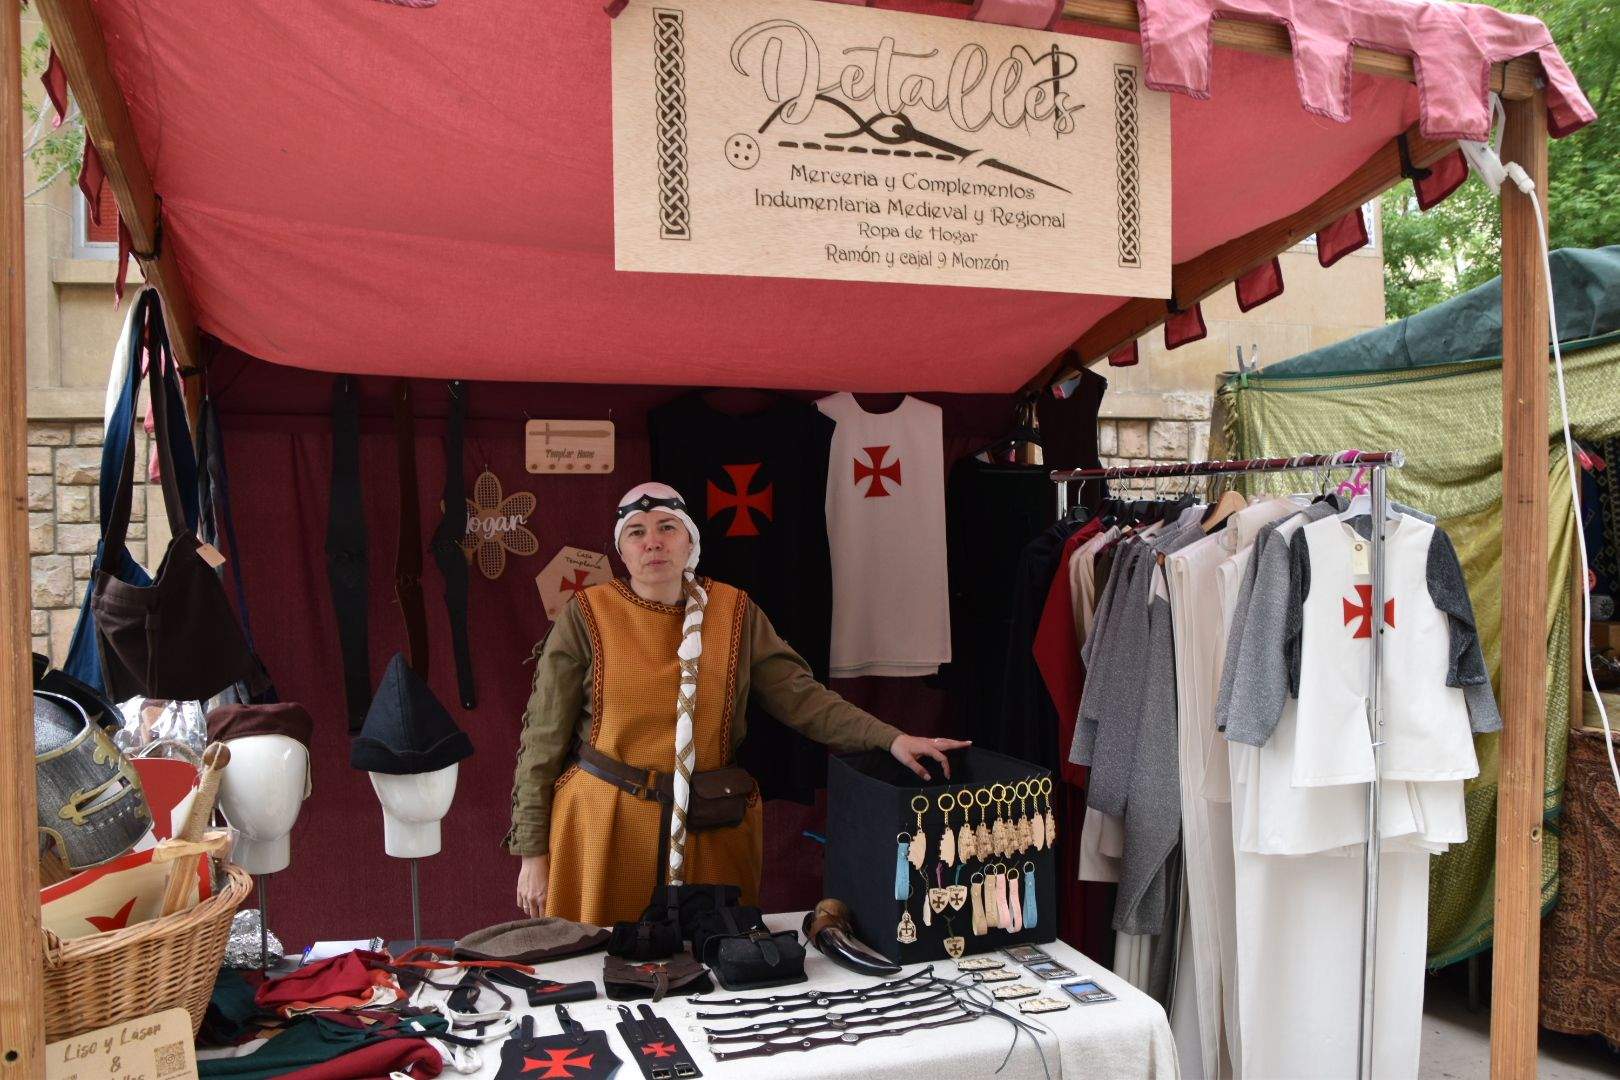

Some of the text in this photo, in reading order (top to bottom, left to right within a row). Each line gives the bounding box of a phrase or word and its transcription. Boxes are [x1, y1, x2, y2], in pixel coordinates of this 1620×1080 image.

[730, 19, 1085, 134] Detalles
[790, 164, 1035, 200] Merceria y Complementos
[755, 188, 1065, 229] Indumentaria Medieval y Regional
[857, 221, 978, 245] Ropa de Hogar
[824, 243, 880, 264] Ramón
[886, 252, 894, 268] y
[899, 251, 932, 268] cajal
[952, 252, 1009, 271] Monzón
[63, 1043, 98, 1063] Liso
[103, 1036, 114, 1054] y
